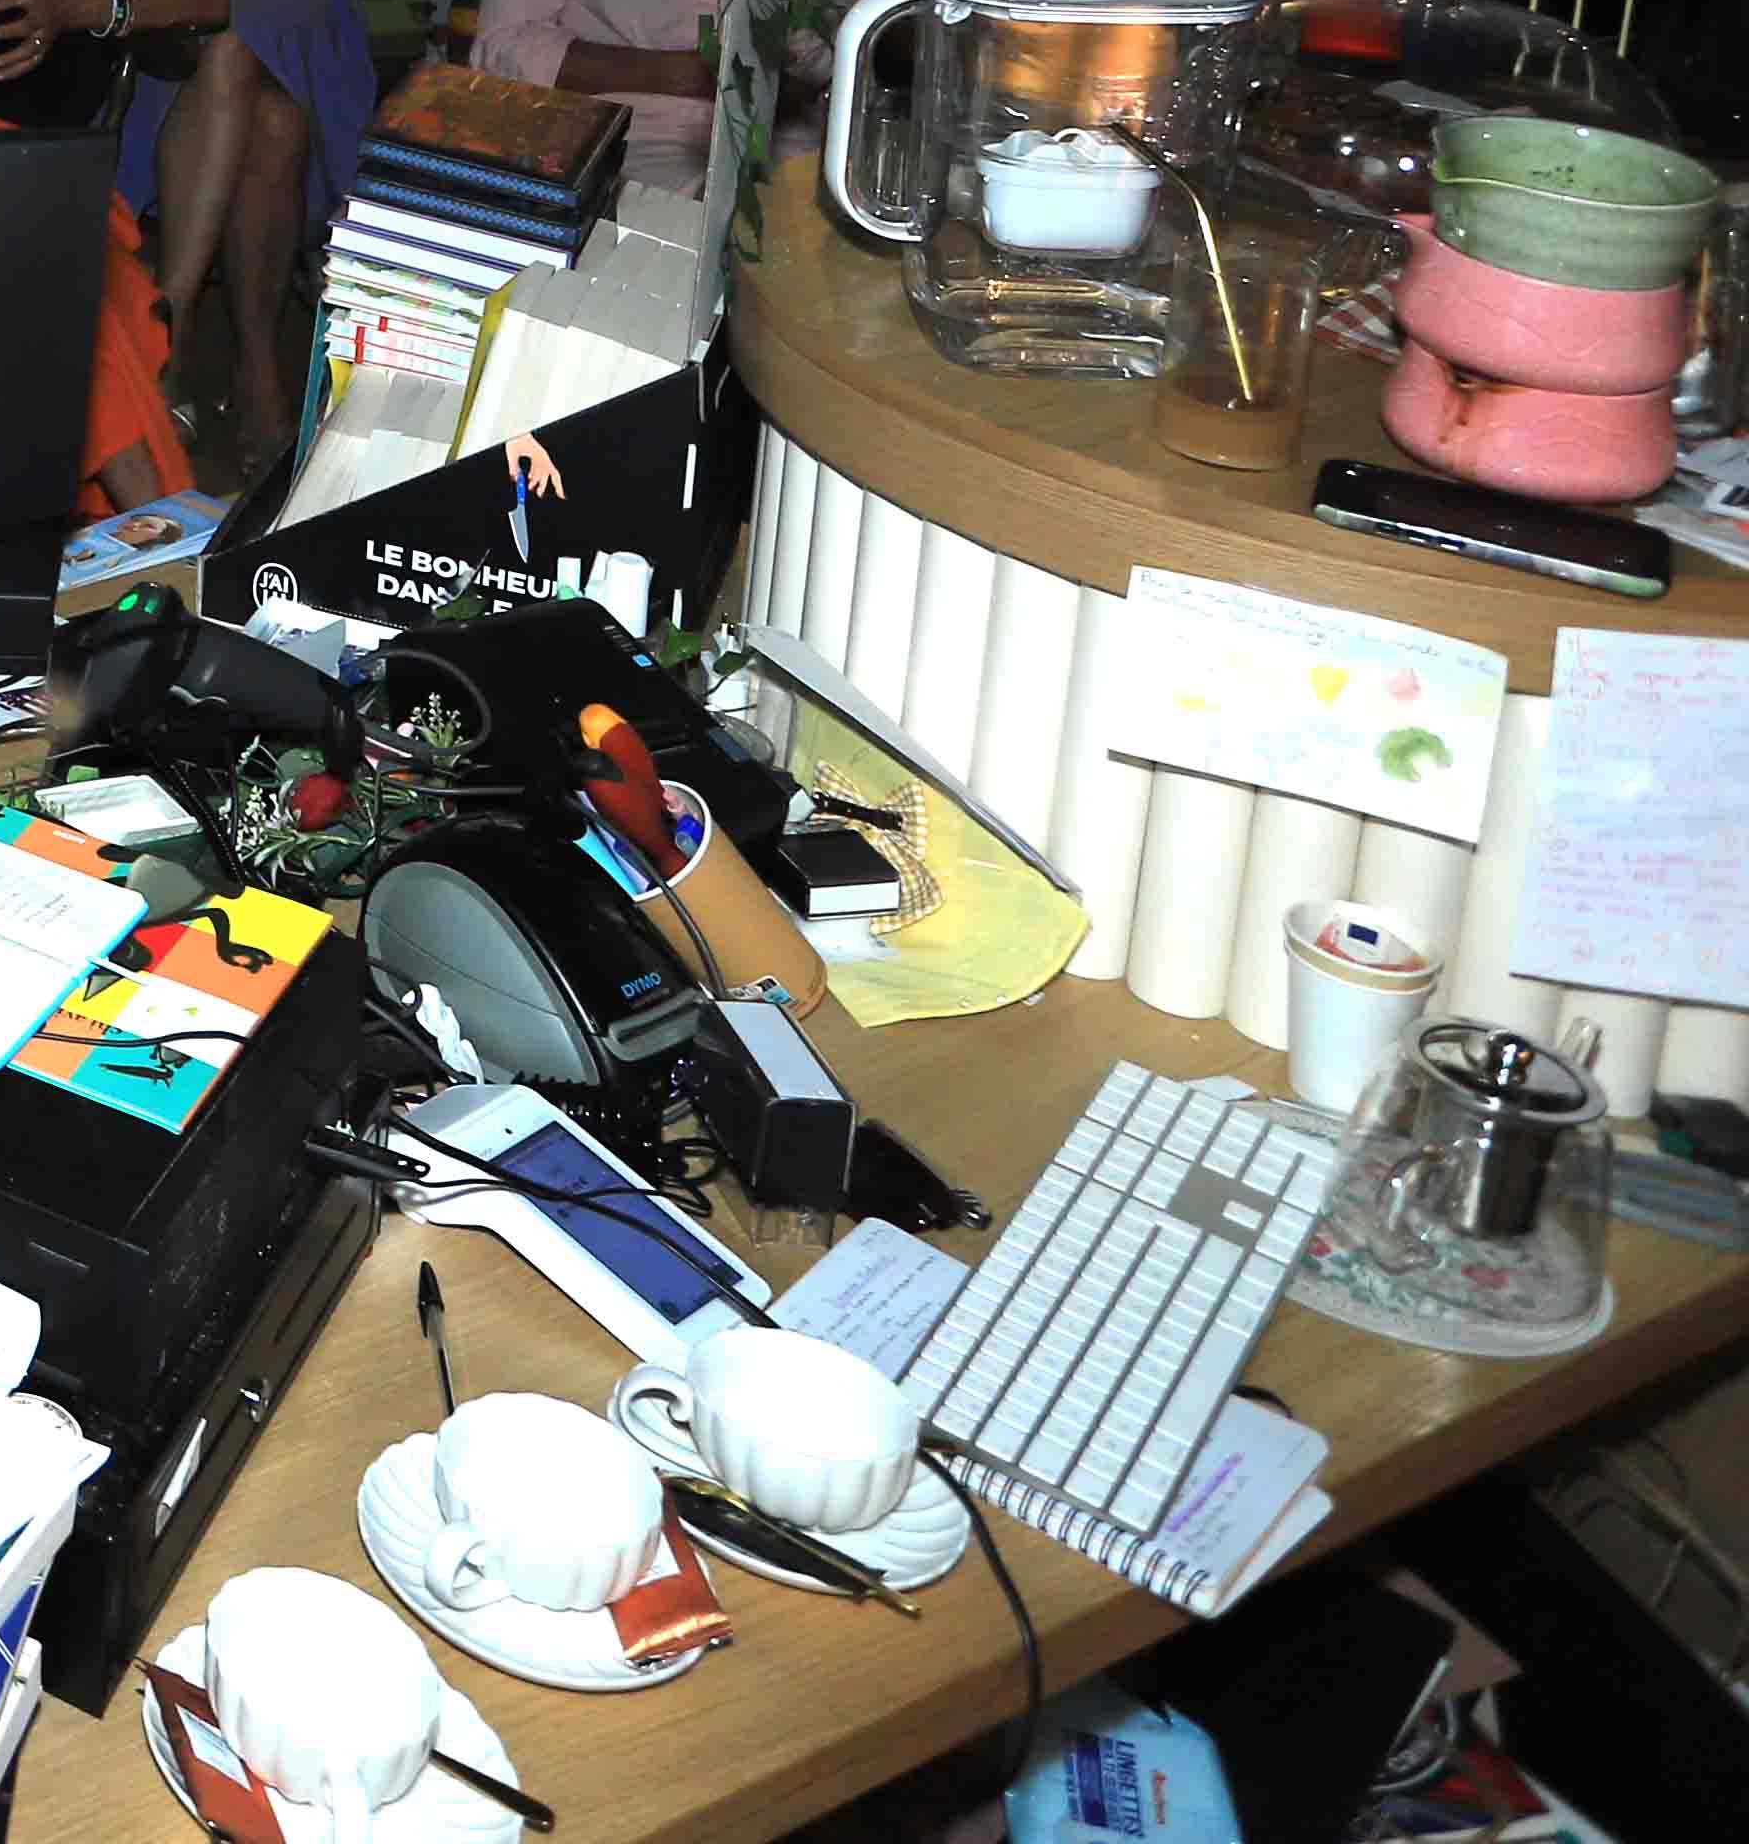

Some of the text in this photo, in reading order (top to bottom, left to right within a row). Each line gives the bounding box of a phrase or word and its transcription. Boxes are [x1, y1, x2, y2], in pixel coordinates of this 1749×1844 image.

[259, 571, 290, 595] J'AI
[365, 539, 561, 600] LE BONHEU
[376, 573, 448, 608] DAN
[619, 971, 663, 999] DYMO
